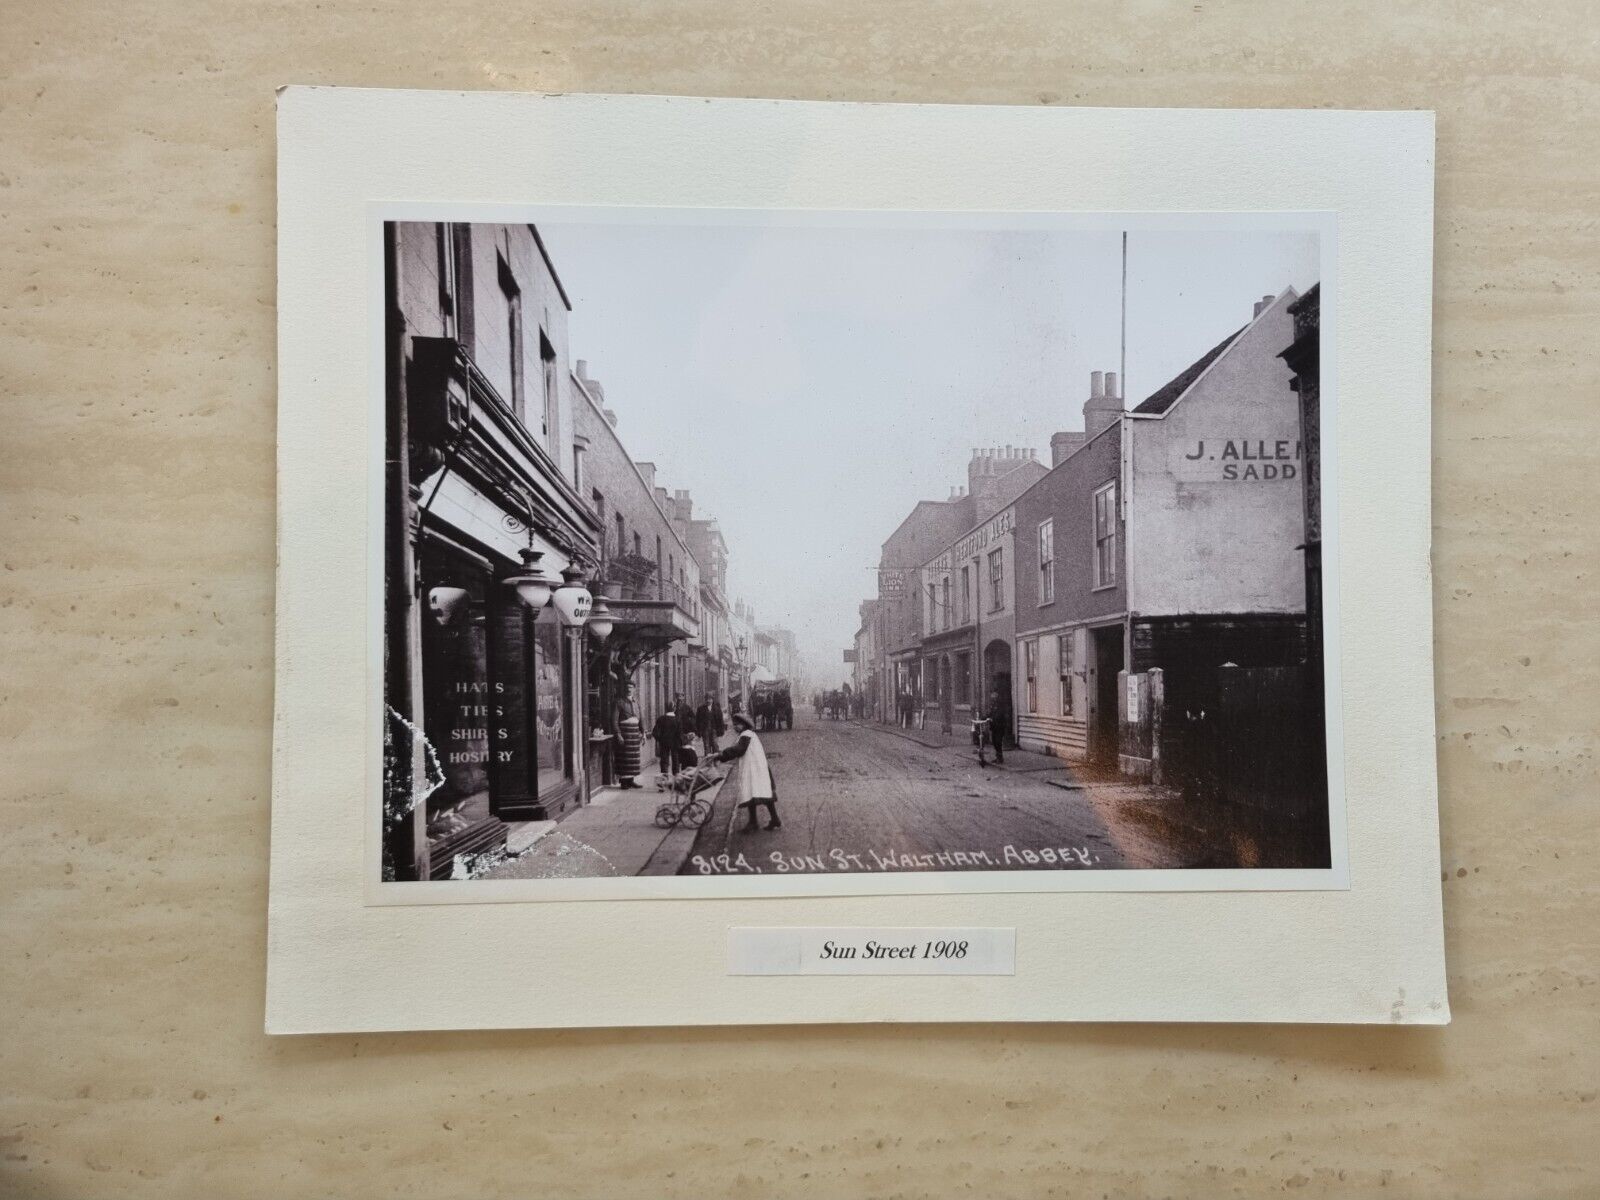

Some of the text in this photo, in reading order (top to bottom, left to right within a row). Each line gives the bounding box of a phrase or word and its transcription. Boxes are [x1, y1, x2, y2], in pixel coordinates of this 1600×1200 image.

[1222, 464, 1296, 480] SADD
[451, 728, 508, 740] SHIRS
[769, 851, 825, 872] SUN
[819, 941, 969, 959] Sun Street 1908
